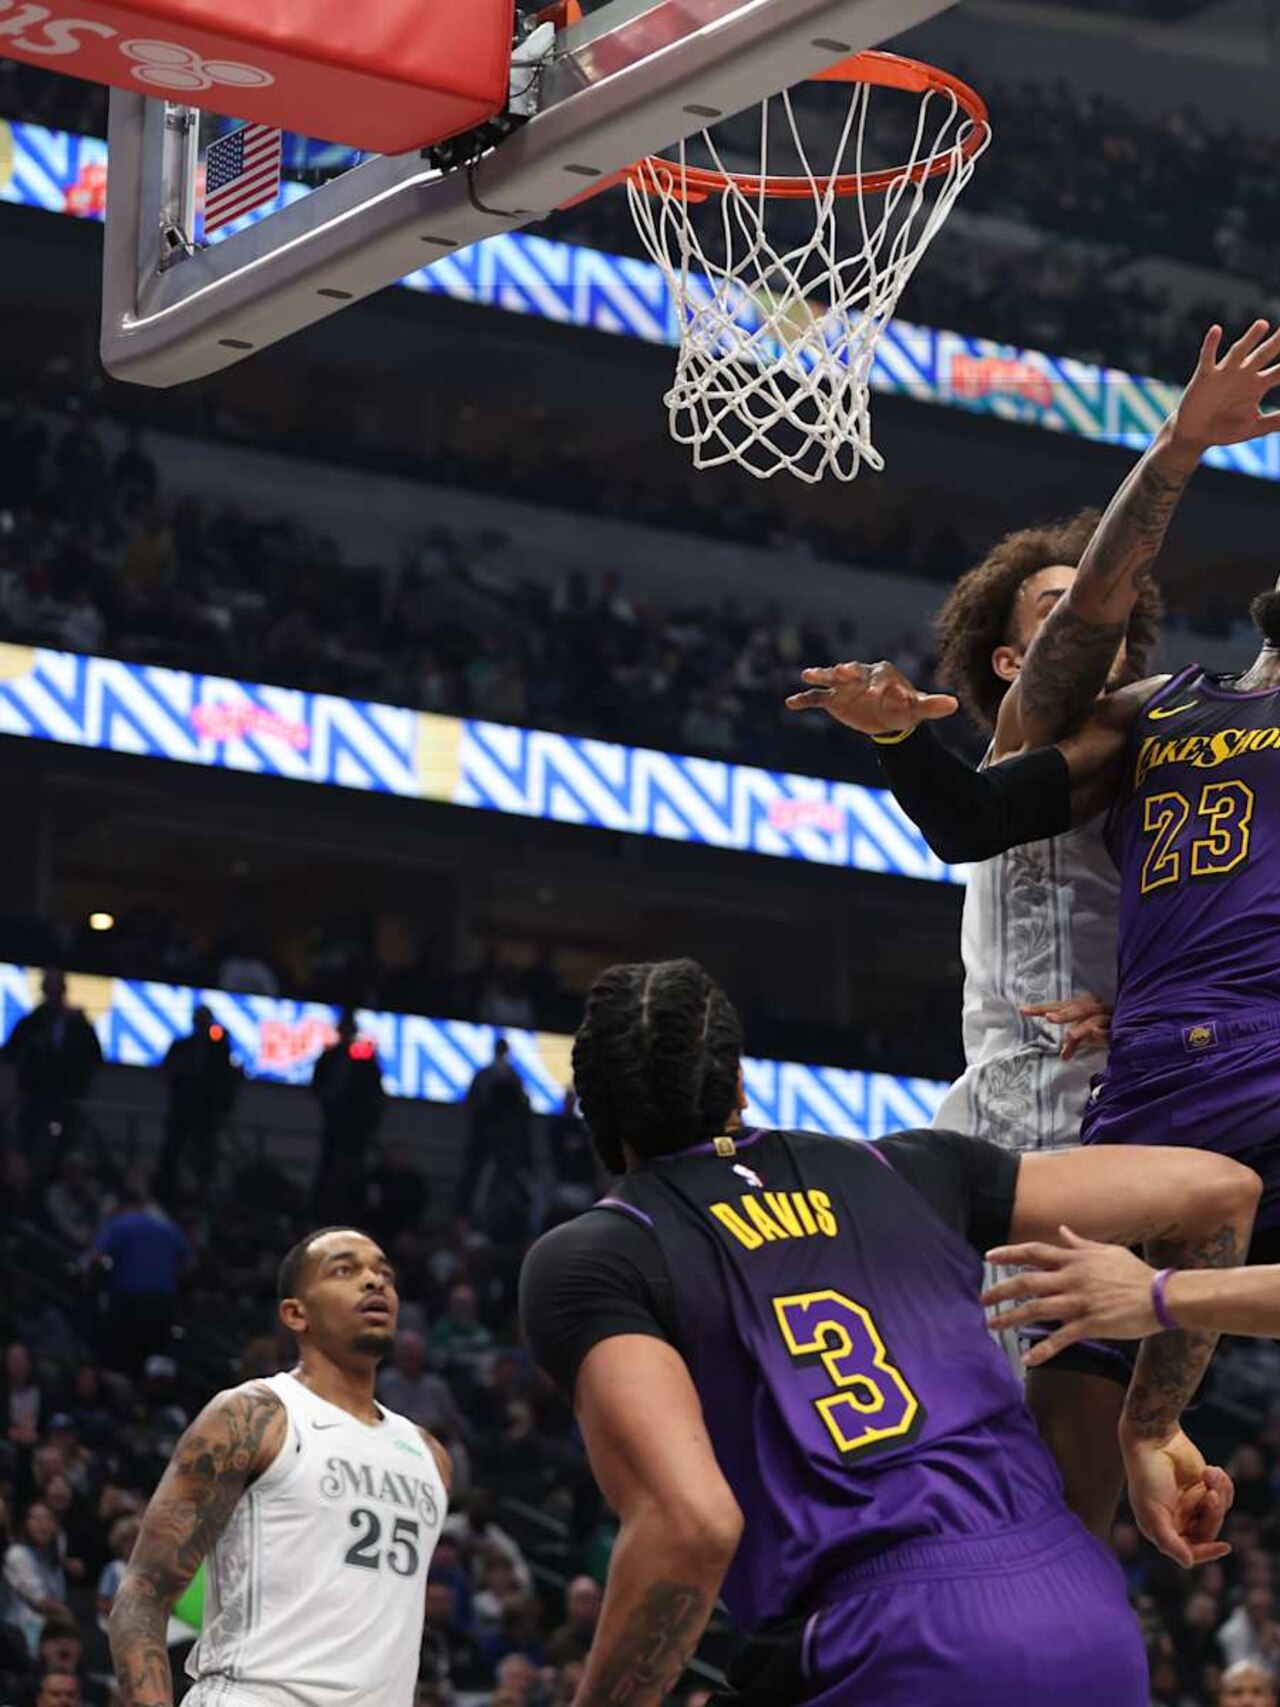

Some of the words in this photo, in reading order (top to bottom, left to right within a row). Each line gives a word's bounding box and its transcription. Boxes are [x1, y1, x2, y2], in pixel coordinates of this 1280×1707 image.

[1141, 779, 1254, 894] 23
[709, 1189, 838, 1250] DAVIS
[772, 1288, 919, 1453] 3
[320, 1457, 438, 1527] MAVS
[344, 1508, 420, 1576] 25
